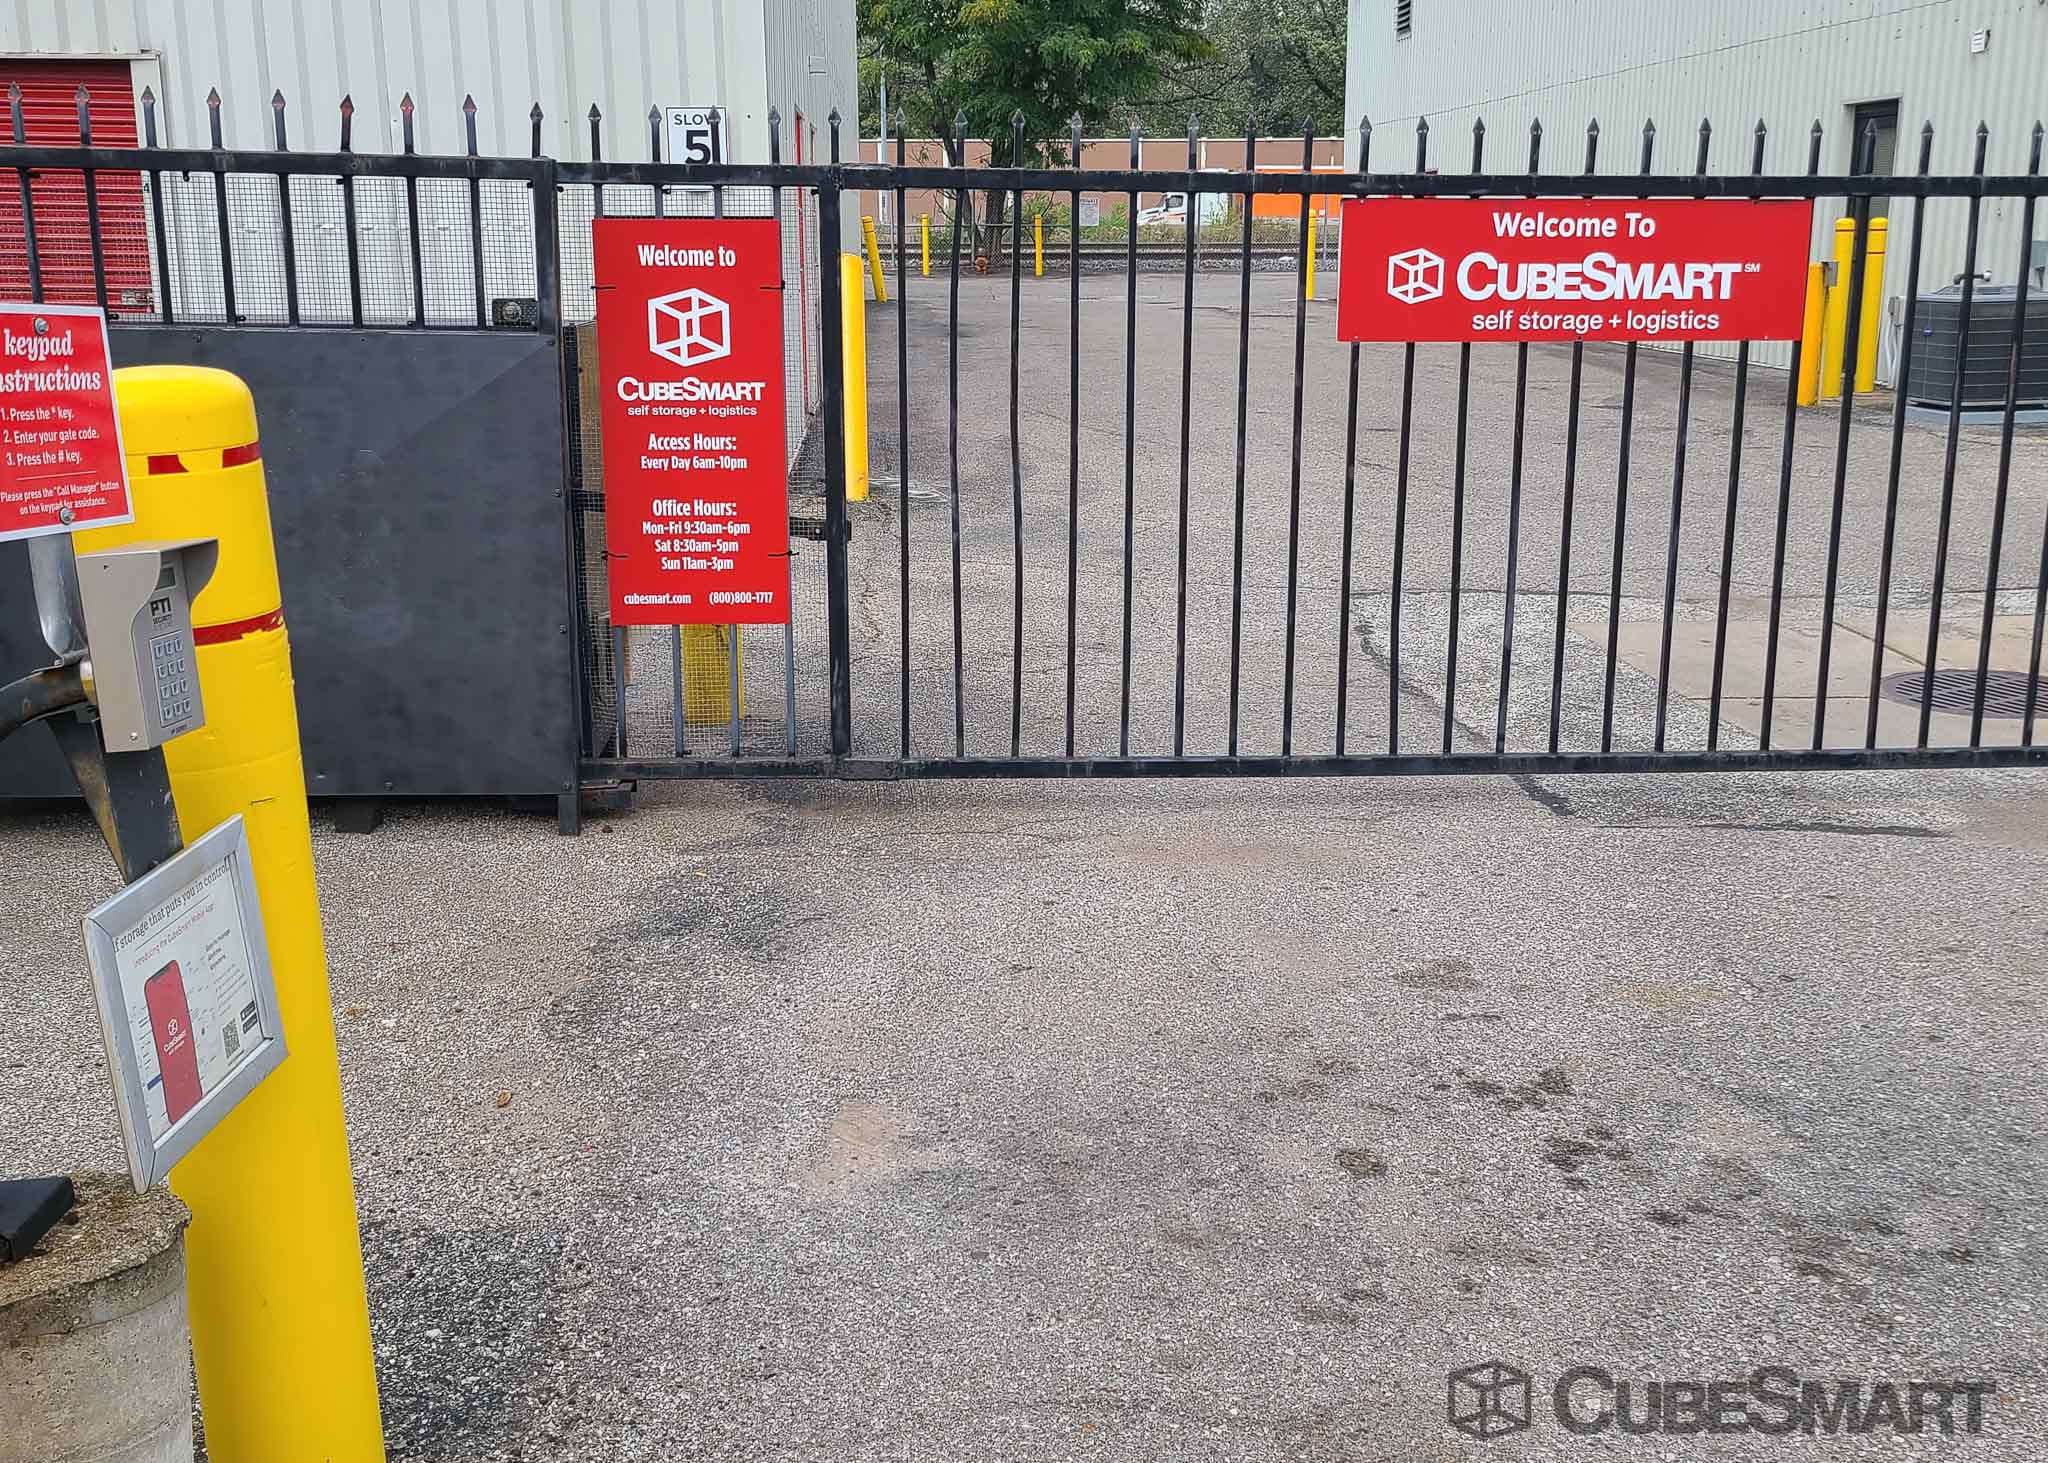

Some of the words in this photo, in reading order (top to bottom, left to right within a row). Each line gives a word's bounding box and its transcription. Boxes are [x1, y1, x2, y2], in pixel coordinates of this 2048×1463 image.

[685, 129, 711, 165] 5
[1492, 211, 1617, 238] Welcome
[1625, 211, 1656, 238] To
[637, 244, 715, 267] Welcome
[718, 245, 737, 267] to
[1472, 309, 1515, 330] self
[1518, 309, 1603, 334] storage
[1626, 309, 1720, 334] logistics
[3, 328, 74, 361] keypad
[10, 407, 36, 422] Press
[36, 407, 51, 420] the
[57, 405, 75, 421] key.
[627, 405, 649, 416] self
[652, 405, 697, 418] storage
[709, 405, 758, 418] logistics
[3, 430, 13, 443] 2.
[13, 431, 37, 444] Enter
[39, 431, 58, 446] your
[58, 428, 77, 445] gate
[78, 426, 100, 440] code.
[648, 433, 691, 450] Access
[693, 433, 737, 450] Hours:
[6, 452, 16, 466] 3.
[17, 452, 41, 466] Press
[41, 450, 57, 464] the
[65, 449, 82, 464] key.
[640, 456, 669, 471] Every
[671, 456, 691, 471] Day
[23, 490, 42, 503] press
[42, 488, 54, 498] the
[100, 480, 119, 492] button
[19, 505, 29, 516] on
[29, 503, 41, 514] the
[652, 499, 691, 516] Office
[693, 499, 737, 516] Hours:
[655, 540, 672, 552] Sat
[661, 557, 680, 570] Sun
[150, 597, 172, 616] PTI
[623, 592, 692, 605] cubesmart.com
[119, 921, 149, 949] storage
[148, 909, 165, 928] that
[165, 896, 183, 917] puts
[181, 887, 196, 906] you
[194, 880, 204, 895] in
